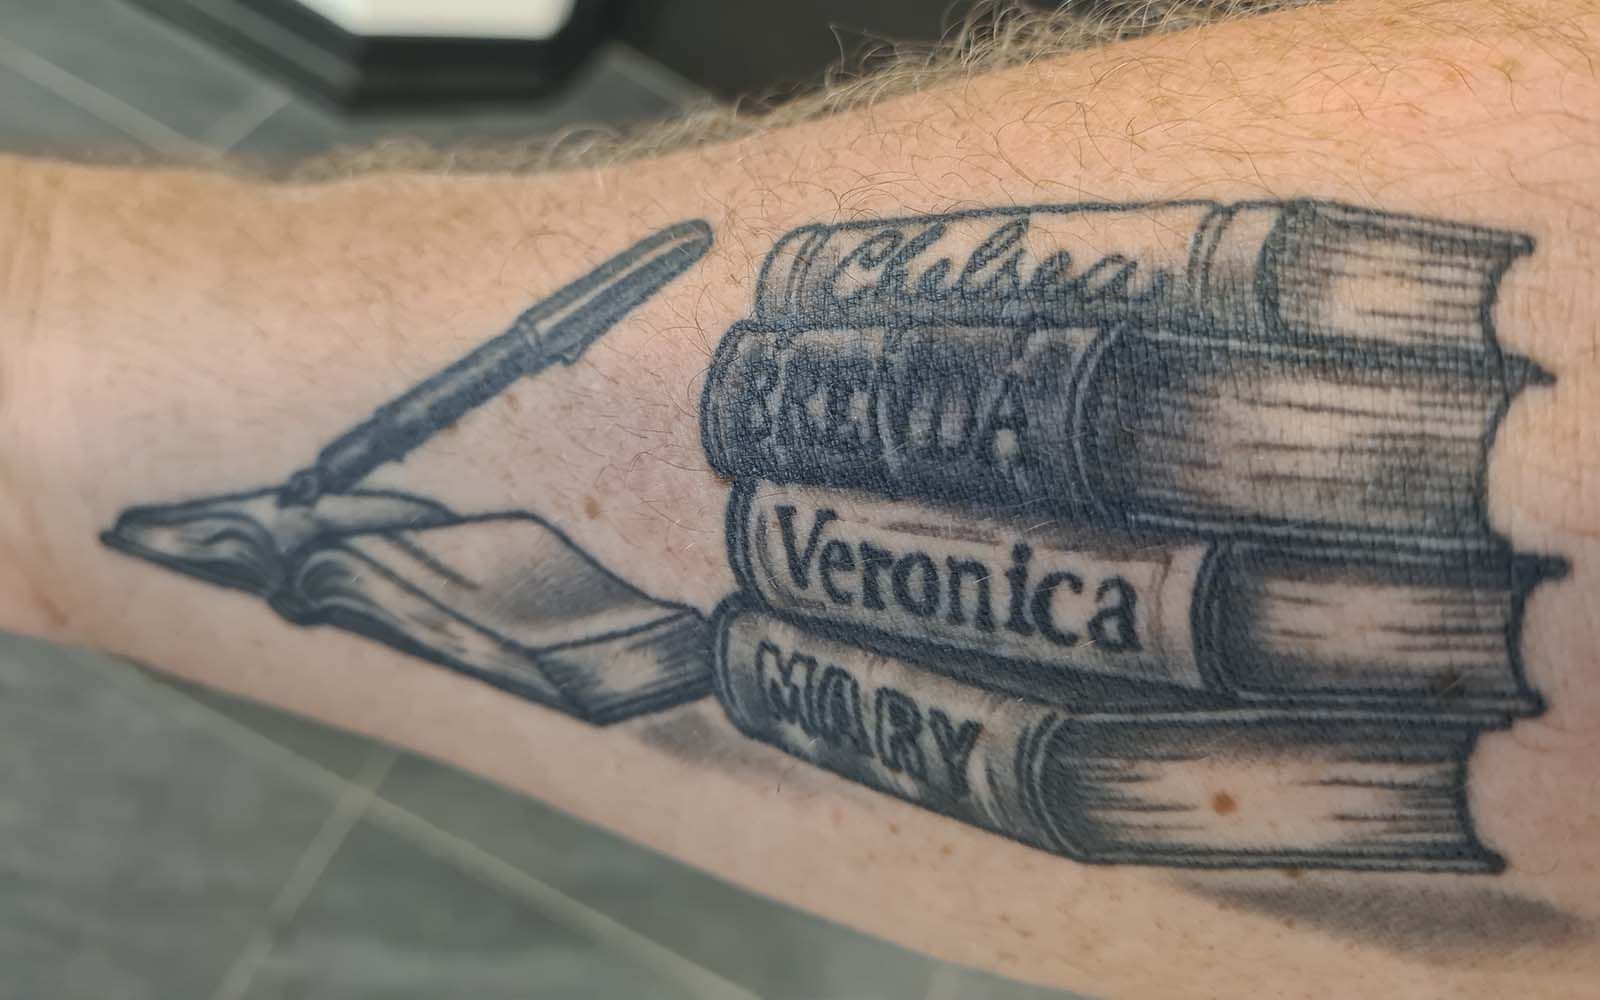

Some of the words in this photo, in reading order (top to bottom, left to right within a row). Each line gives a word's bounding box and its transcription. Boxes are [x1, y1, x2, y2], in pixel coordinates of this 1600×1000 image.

[829, 217, 1167, 303] Chelsea
[774, 505, 1143, 652] Veronica
[755, 639, 984, 799] MARY
